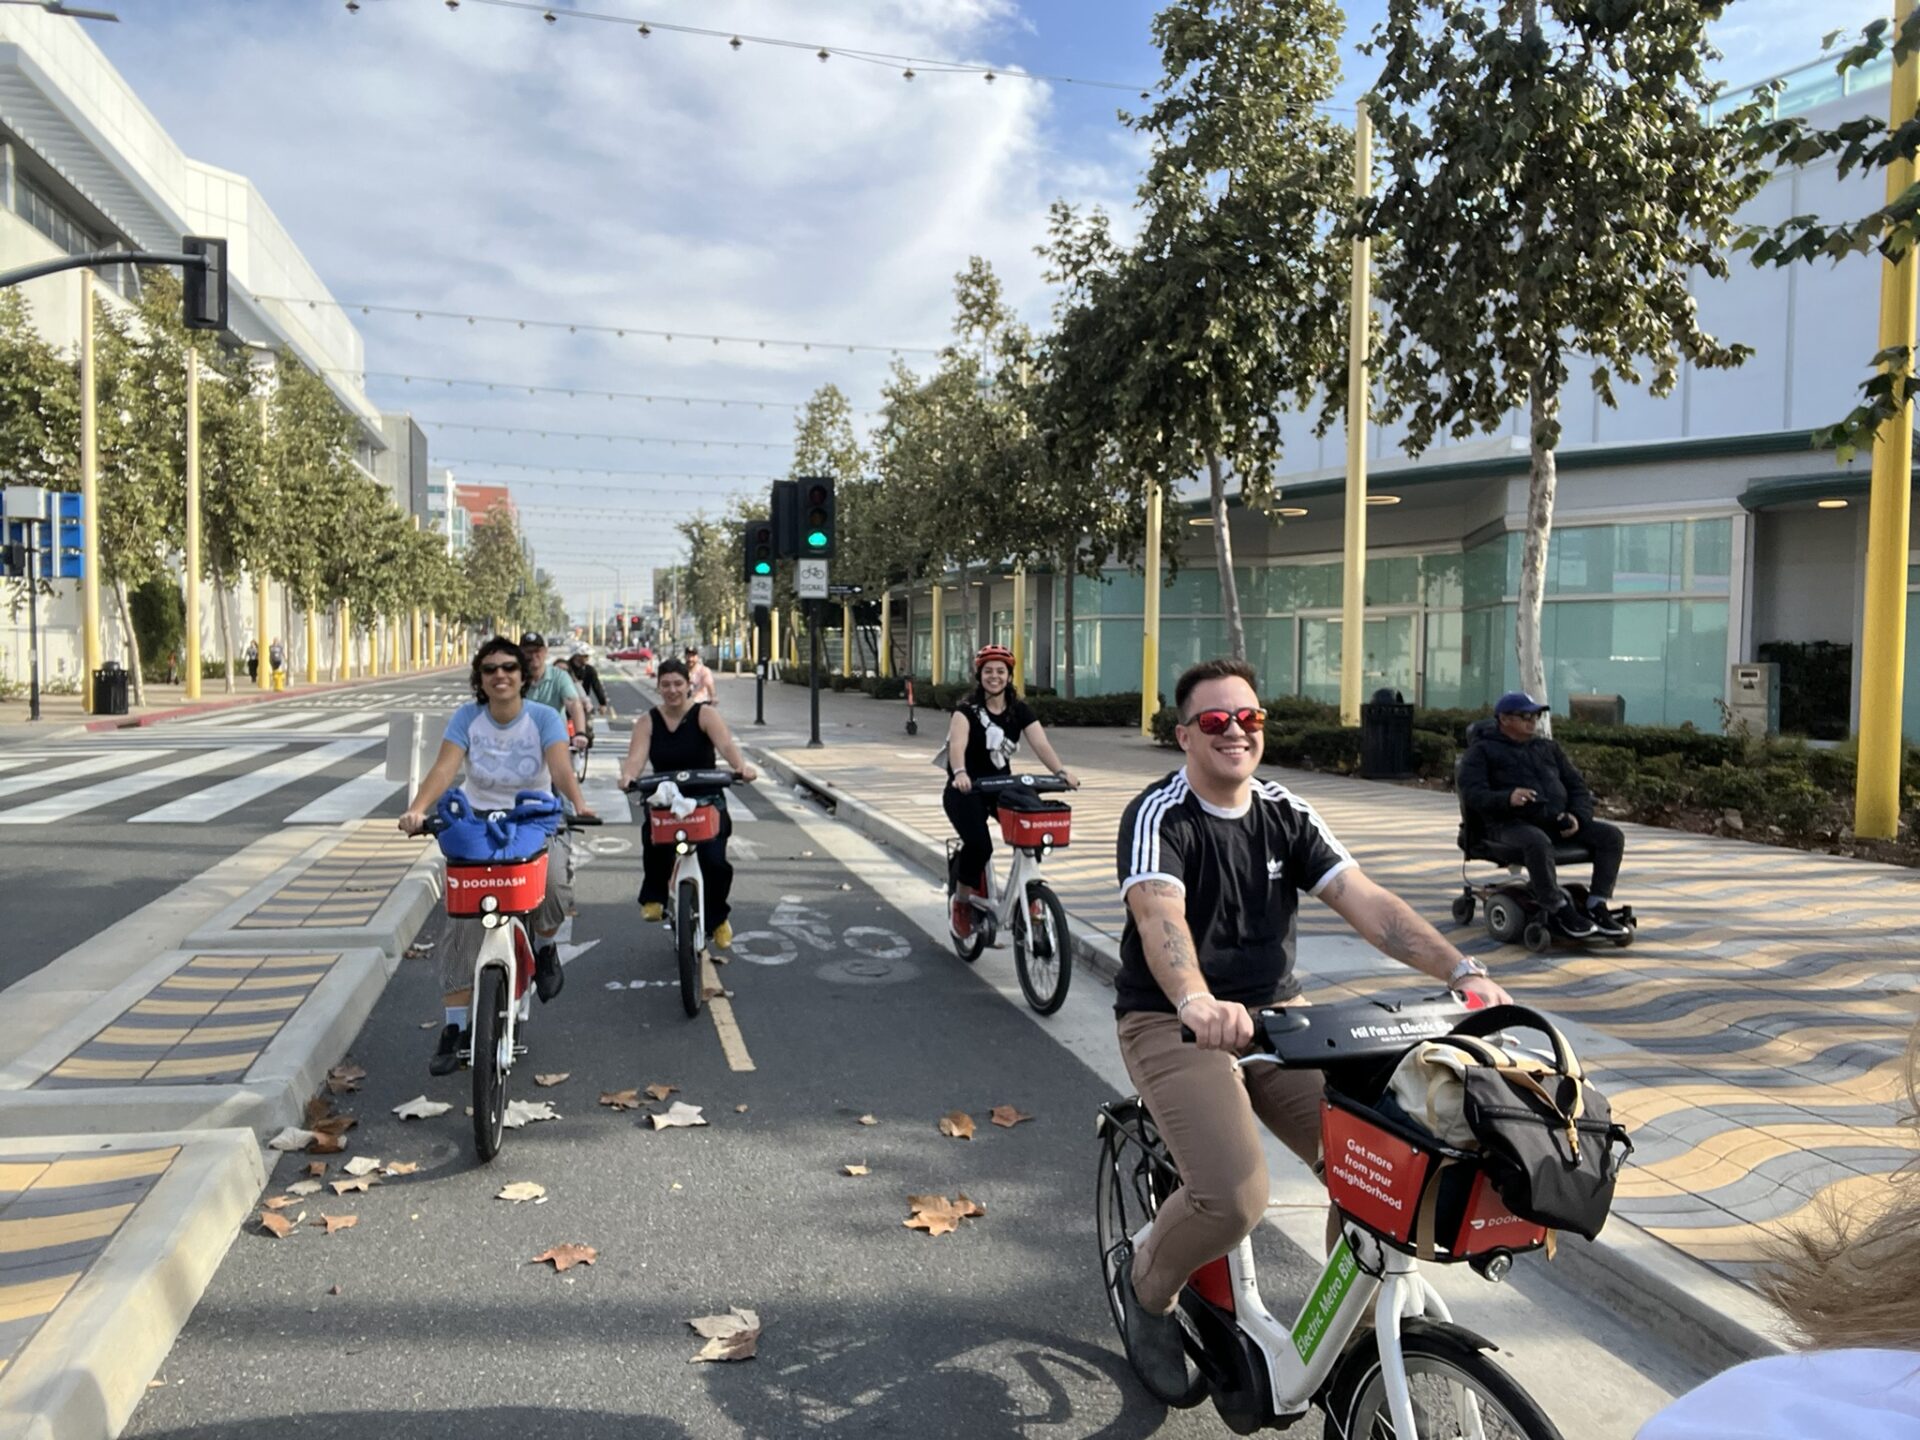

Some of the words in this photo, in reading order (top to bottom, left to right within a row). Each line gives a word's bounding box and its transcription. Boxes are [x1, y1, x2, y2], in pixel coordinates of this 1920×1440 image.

[462, 876, 526, 889] DOORDASH
[1369, 1026, 1387, 1037] I'm
[1388, 1026, 1402, 1035] an
[1344, 1153, 1368, 1174] from
[1369, 1169, 1392, 1187] your
[1347, 1138, 1366, 1157] Get
[1367, 1151, 1393, 1172] more
[1332, 1165, 1402, 1210] neighborhood
[1297, 1311, 1324, 1357] Electric
[1319, 1277, 1343, 1316] Metro
[1338, 1252, 1356, 1280] Bik
